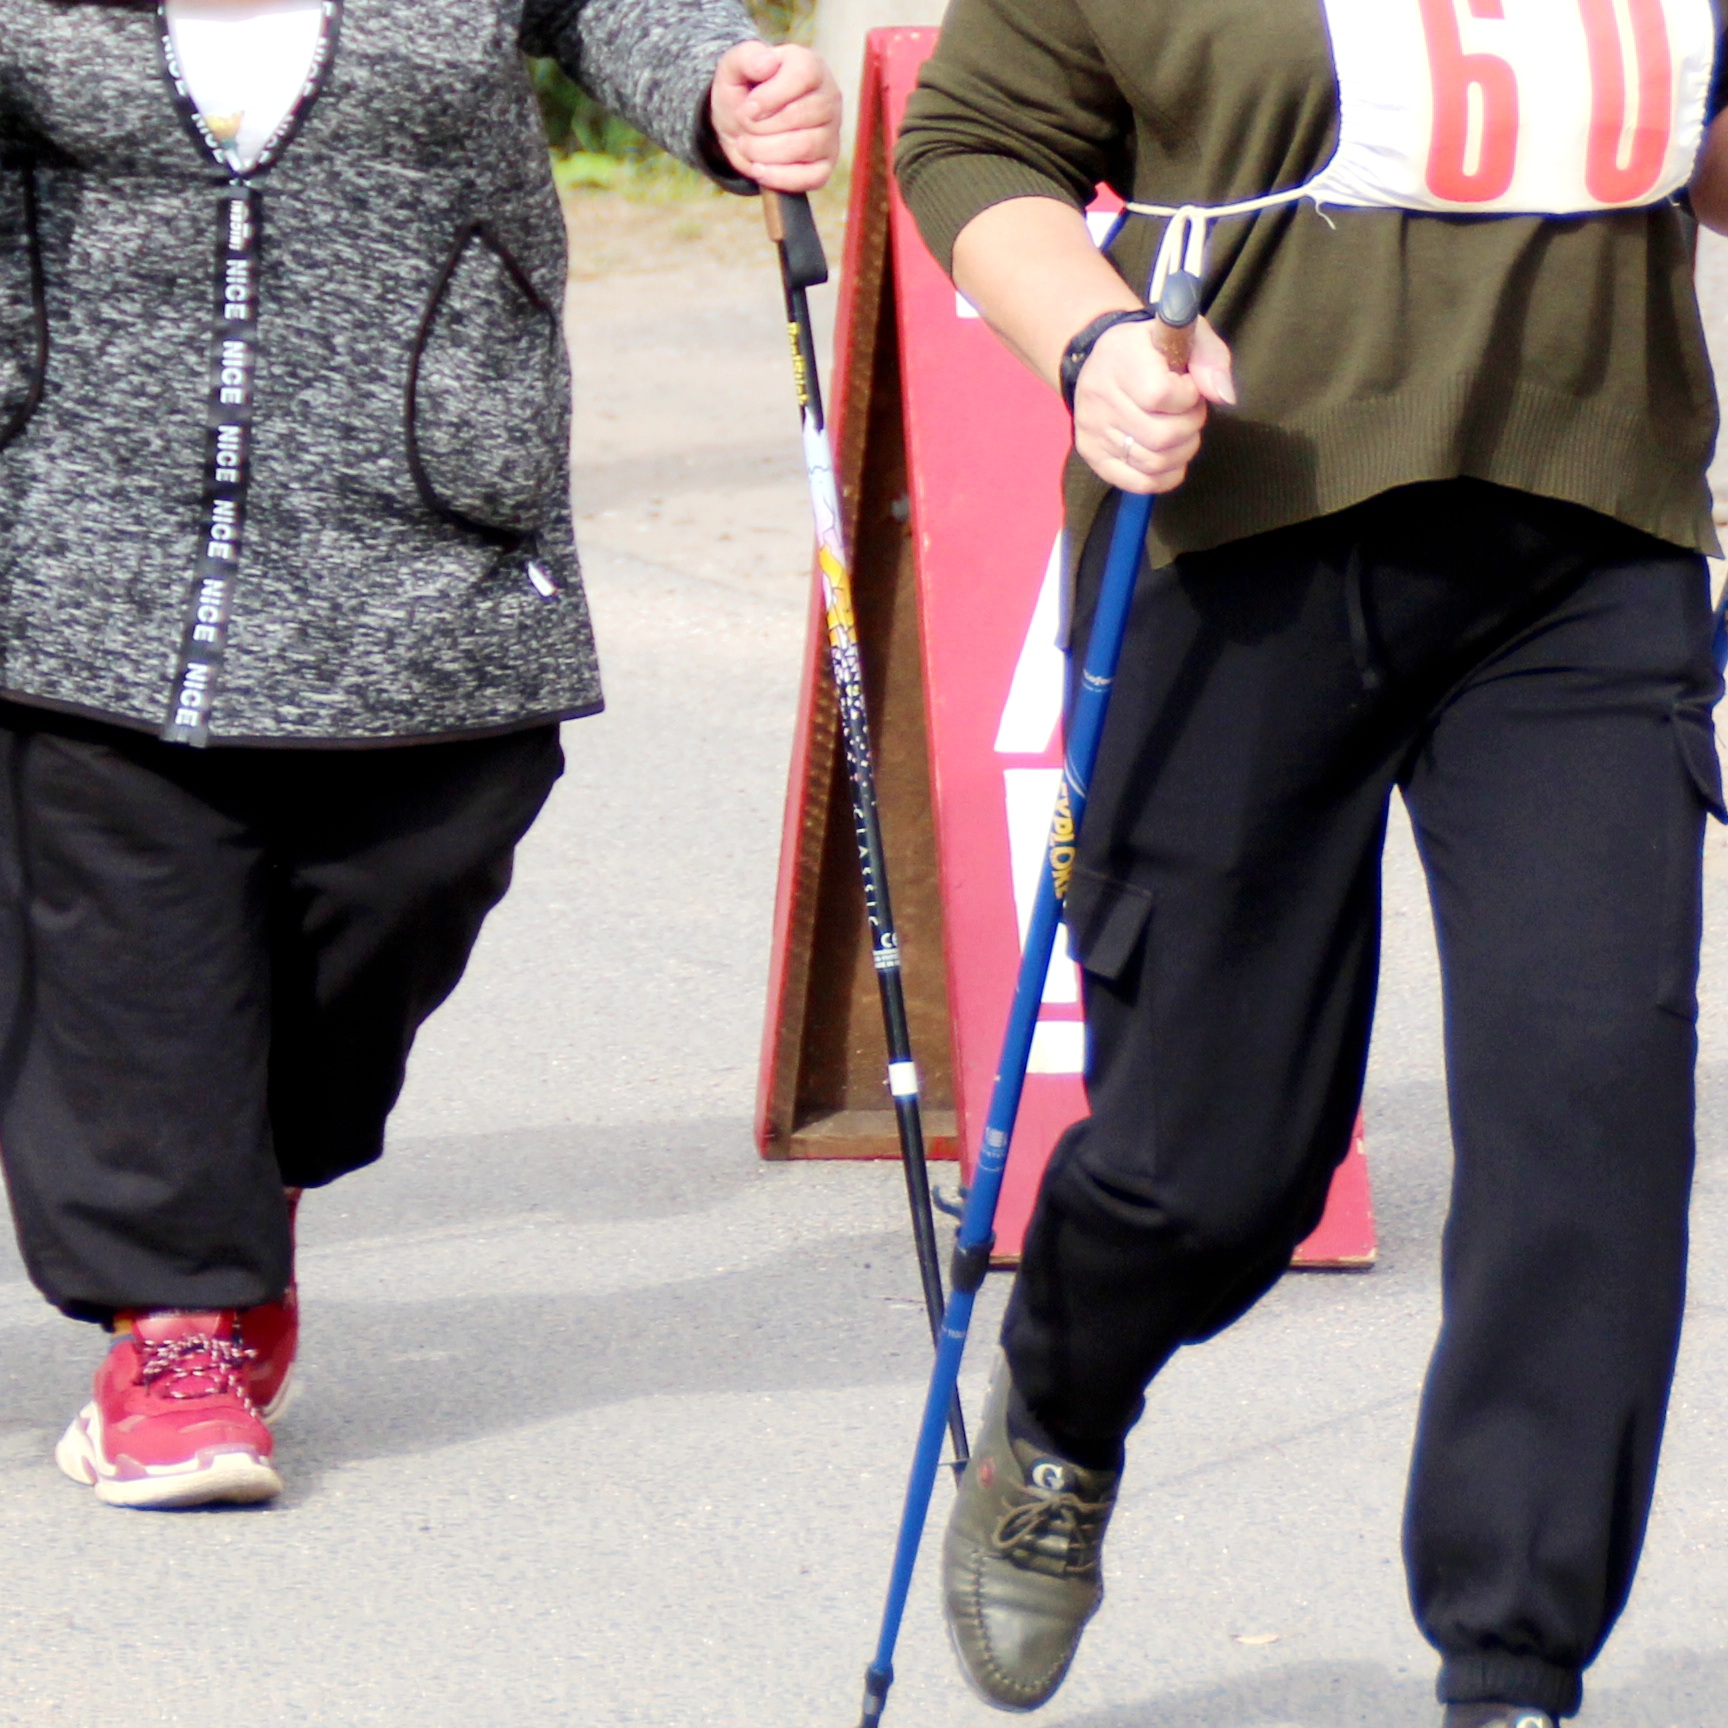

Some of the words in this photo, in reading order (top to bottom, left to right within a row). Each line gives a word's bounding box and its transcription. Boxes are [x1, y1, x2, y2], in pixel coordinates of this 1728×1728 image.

[224, 259, 249, 320] NICE
[220, 340, 246, 404] NICE
[216, 425, 241, 483] NICE
[207, 499, 235, 559] NICE
[193, 579, 224, 643] NICE
[175, 662, 209, 727] NICE
